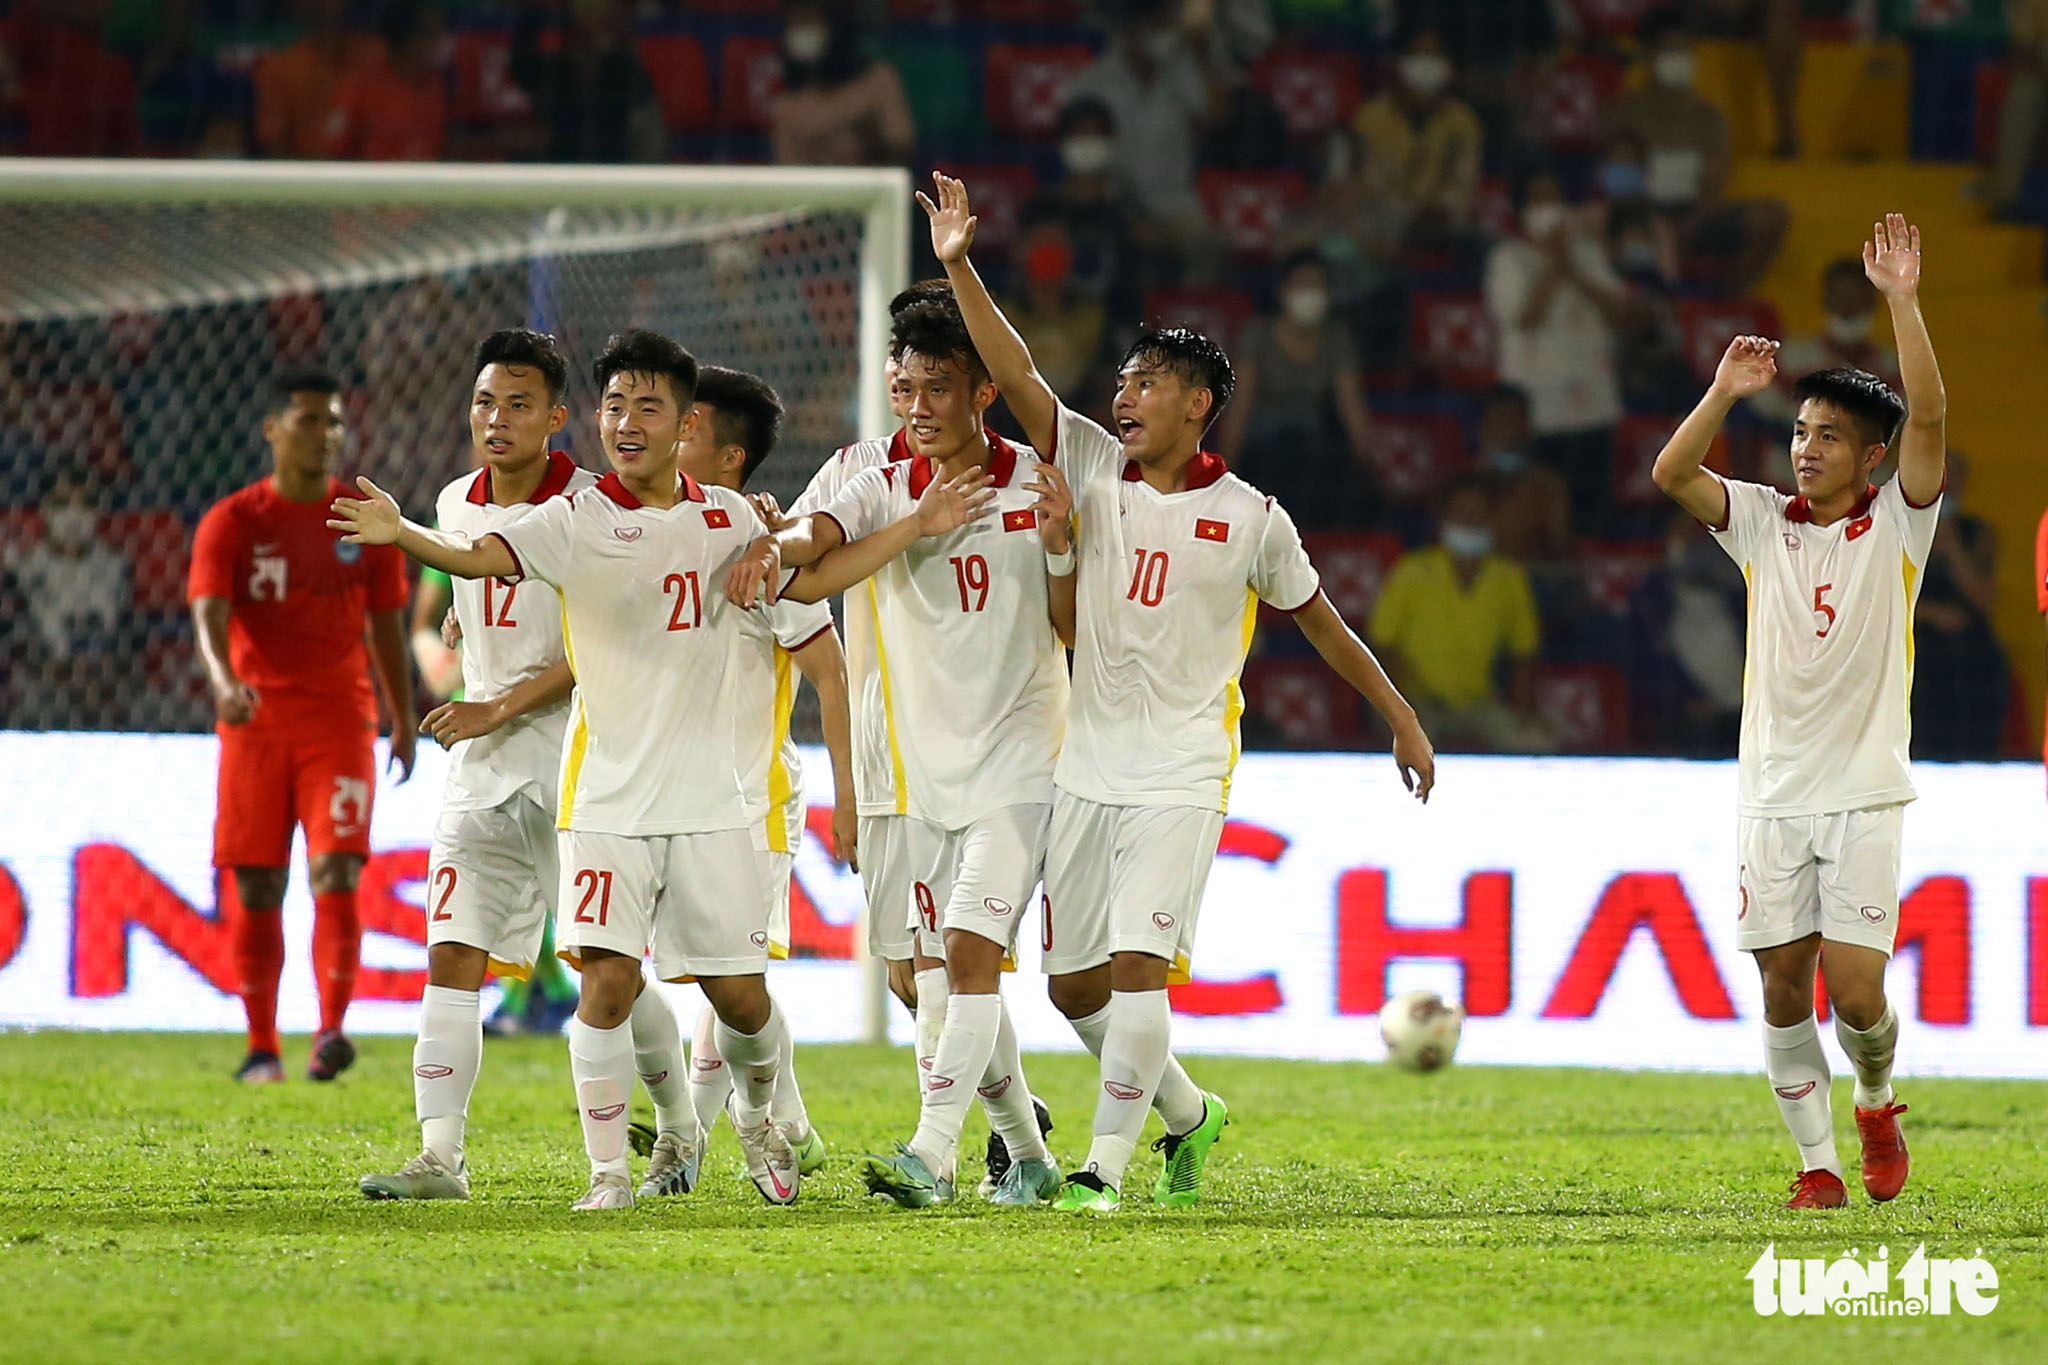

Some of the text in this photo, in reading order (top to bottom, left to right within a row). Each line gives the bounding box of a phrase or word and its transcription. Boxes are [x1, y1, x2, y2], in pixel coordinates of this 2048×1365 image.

[484, 575, 517, 627] 12
[663, 570, 701, 631] 21
[949, 554, 989, 613] 19
[1126, 548, 1170, 607] 10
[1814, 583, 1837, 638] 5
[573, 868, 613, 927] 21
